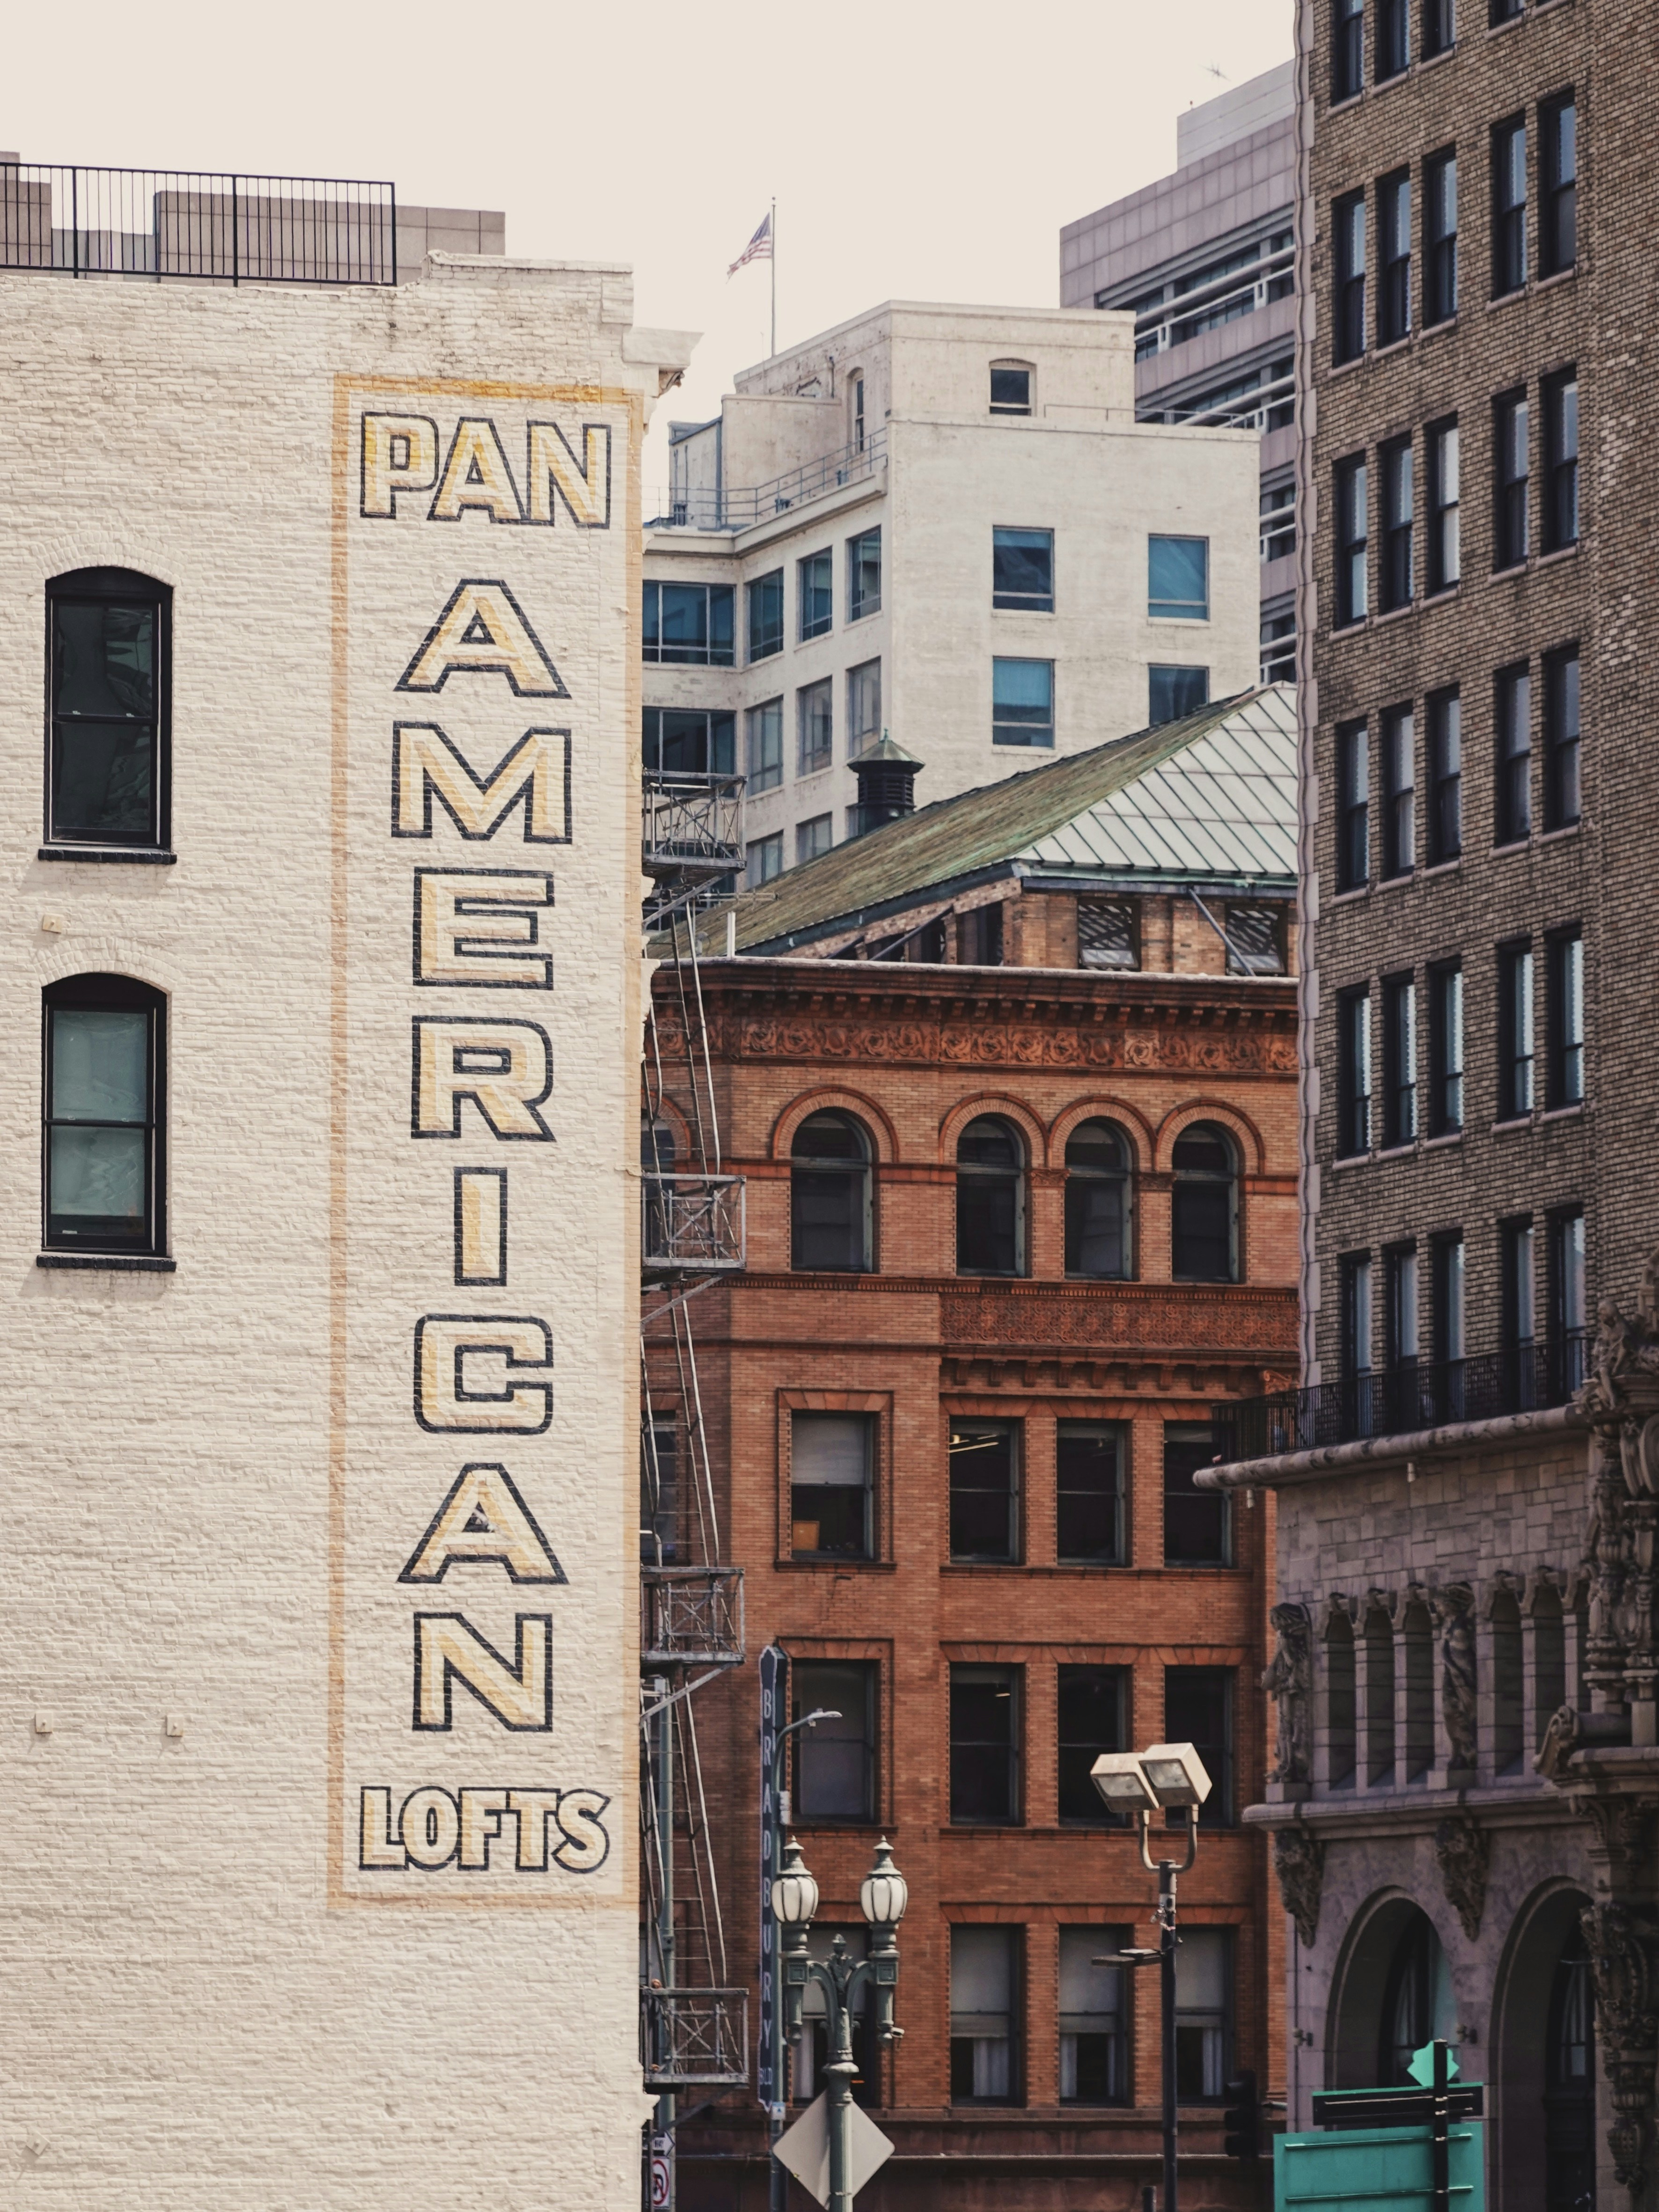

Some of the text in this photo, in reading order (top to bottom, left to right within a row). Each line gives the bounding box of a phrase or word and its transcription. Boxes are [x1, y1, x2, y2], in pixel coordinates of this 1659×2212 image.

[360, 411, 611, 529] PAN
[391, 579, 572, 1732] AMERICAN
[359, 1786, 611, 1874] LOFTS
[763, 1689, 772, 2049] BRADBURY
